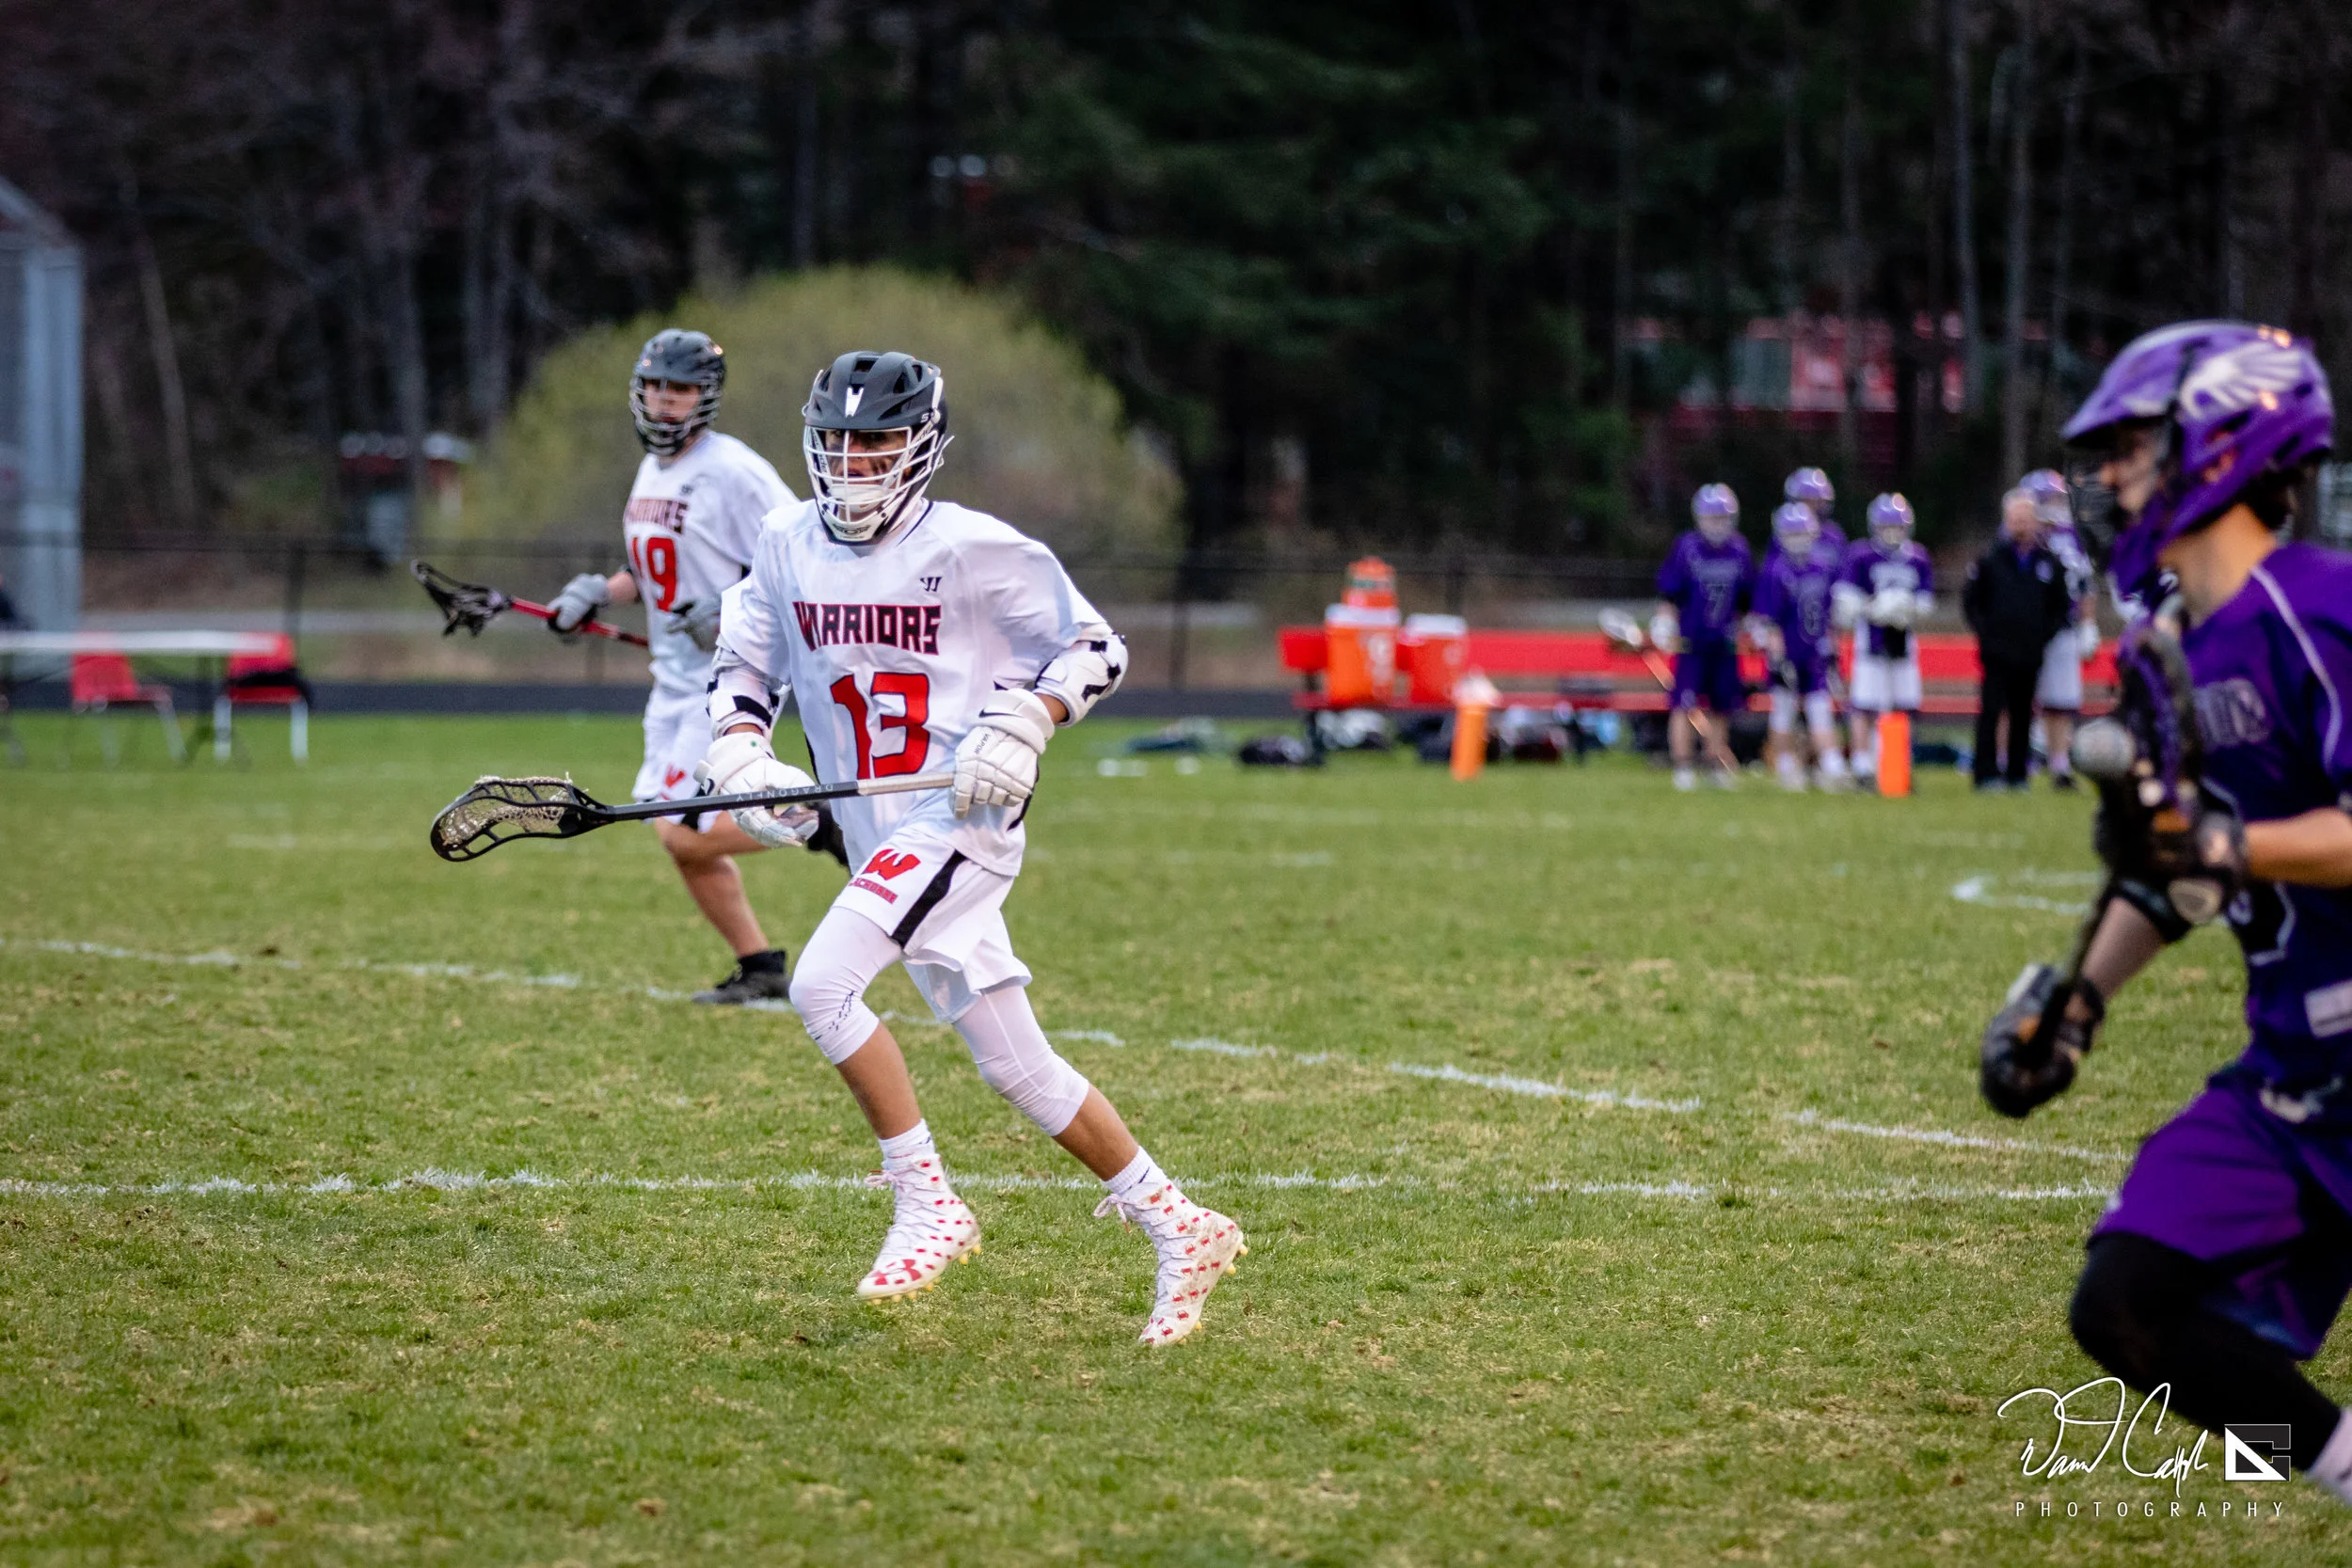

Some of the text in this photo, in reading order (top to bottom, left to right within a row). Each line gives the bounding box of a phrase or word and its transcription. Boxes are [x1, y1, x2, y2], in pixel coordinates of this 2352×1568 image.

[631, 536, 677, 613] 19
[830, 672, 930, 780] 13
[974, 733, 992, 755] VAPOR
[736, 783, 834, 802] DRAGONFLY
